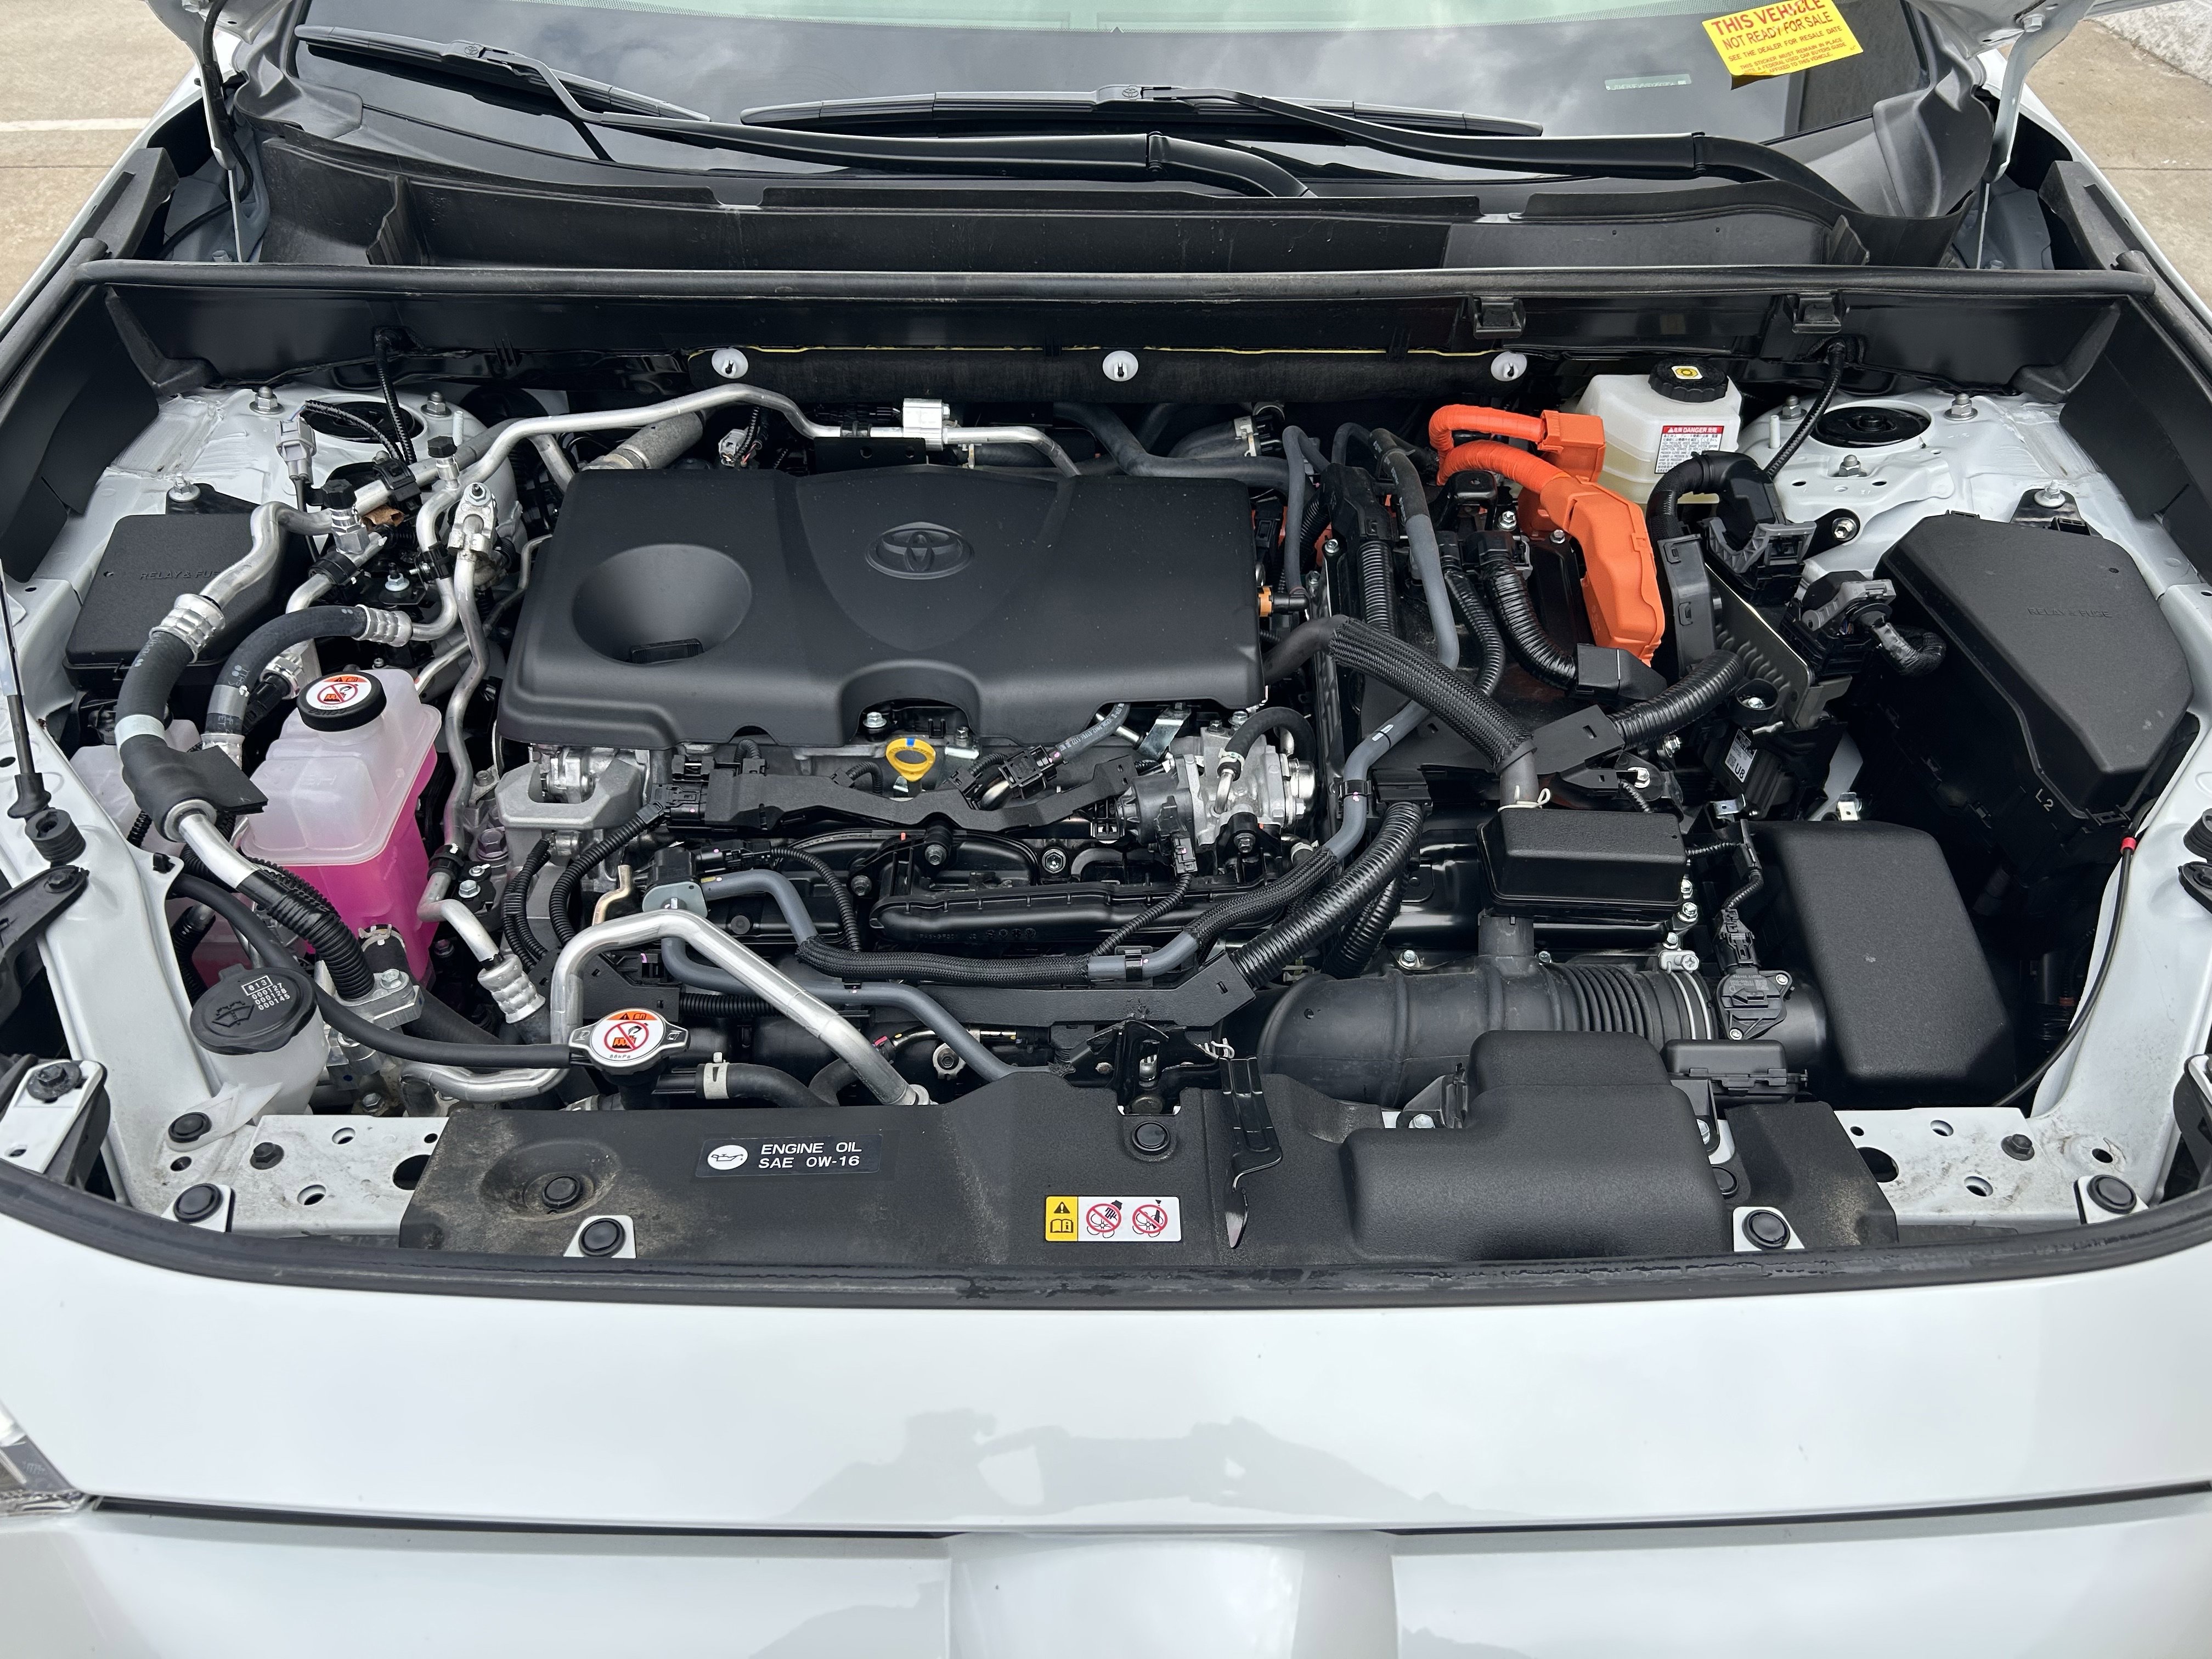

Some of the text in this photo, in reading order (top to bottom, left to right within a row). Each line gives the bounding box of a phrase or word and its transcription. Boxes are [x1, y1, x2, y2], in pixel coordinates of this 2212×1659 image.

[1711, 0, 1825, 35] THIS VEHICLE
[1722, 12, 1833, 50] NOT READY FOR SALE
[1757, 43, 1782, 54] DEALER
[1799, 31, 1825, 42] RESALE
[1826, 26, 1842, 34] DATE
[1754, 56, 1777, 66] STICKER
[1796, 45, 1818, 54] REMAIN
[1825, 37, 1843, 46] PLACE
[1762, 60, 1785, 69] FEDERAL
[1811, 47, 1831, 55] BUYERS
[139, 571, 182, 579] RELAY
[2027, 607, 2065, 616] RELAY
[1735, 763, 1745, 779] U8
[252, 983, 283, 1000] 000127
[258, 994, 290, 1010] 000145
[761, 1142, 862, 1155] ENGINE OIL
[758, 1155, 860, 1169] SAE 0W-16
